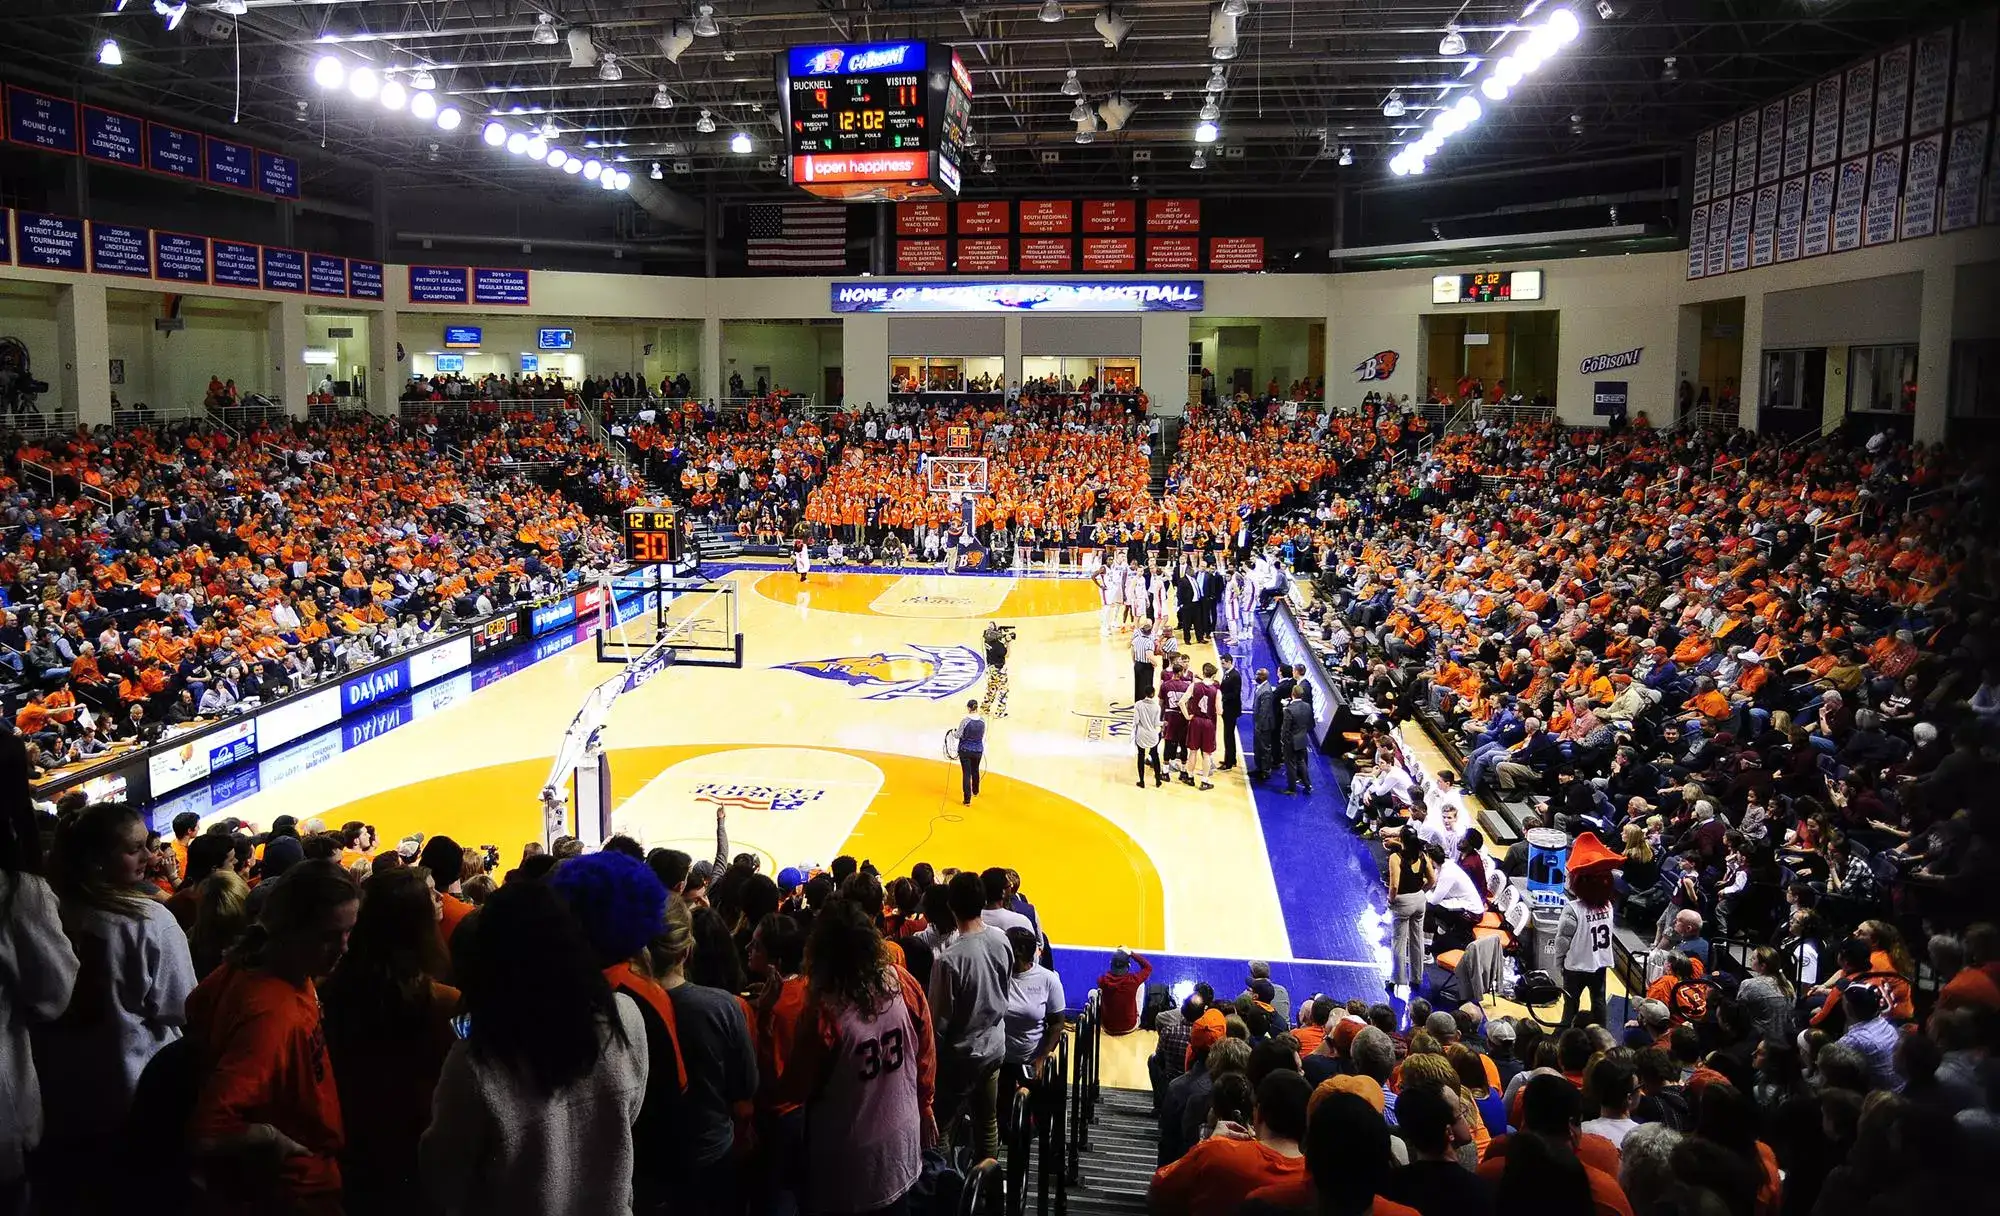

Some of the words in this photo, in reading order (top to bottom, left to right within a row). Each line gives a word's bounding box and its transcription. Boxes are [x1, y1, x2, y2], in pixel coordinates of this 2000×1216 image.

[793, 80, 832, 91] BUCKNELL
[886, 77, 917, 86] VISITOR
[816, 89, 828, 110] 9
[899, 86, 917, 106] 11
[37, 110, 51, 119] NIT
[839, 110, 885, 131] 12:02
[22, 119, 46, 130] ROUND
[47, 125, 57, 133] OF
[105, 124, 122, 133] NCAA
[794, 120, 803, 133] 4
[916, 116, 924, 129] 4
[109, 134, 130, 144] ROUND
[823, 138, 832, 150] 4
[894, 135, 902, 148] 3
[814, 161, 847, 175] open
[849, 159, 914, 174] happiness
[24, 226, 50, 236] PATRIOT
[52, 229, 78, 240] LEAGUE
[29, 235, 73, 247] TOURNAMENT
[98, 235, 121, 243] PATRIOT
[121, 238, 142, 247] LEAGUE
[33, 245, 72, 257] CHAMPIONS
[104, 243, 138, 253] UNDEFEATED
[160, 244, 182, 253] PATRIOT
[182, 247, 202, 256] LEAGUE
[97, 249, 122, 259] REGULAR
[123, 252, 145, 261] SEASON
[159, 252, 184, 262] REGULAR
[184, 255, 204, 265] SEASON
[217, 252, 236, 260] PATRIOT
[237, 255, 255, 263] LEAGUE
[162, 261, 202, 273] CO-CHAMPIONS
[216, 260, 237, 269] REGULAR
[238, 263, 256, 271] SEASON
[272, 280, 297, 289] CHAMPIONS
[422, 293, 455, 301] CHAMPIONS
[838, 287, 889, 303] HOME
[891, 287, 917, 302] OF
[1080, 285, 1199, 303] BASKETBALL
[634, 532, 668, 561] 30
[352, 670, 399, 704] DASANI
[1198, 695, 1209, 714] 4
[1590, 924, 1611, 953] 13
[854, 1028, 904, 1082] 33
